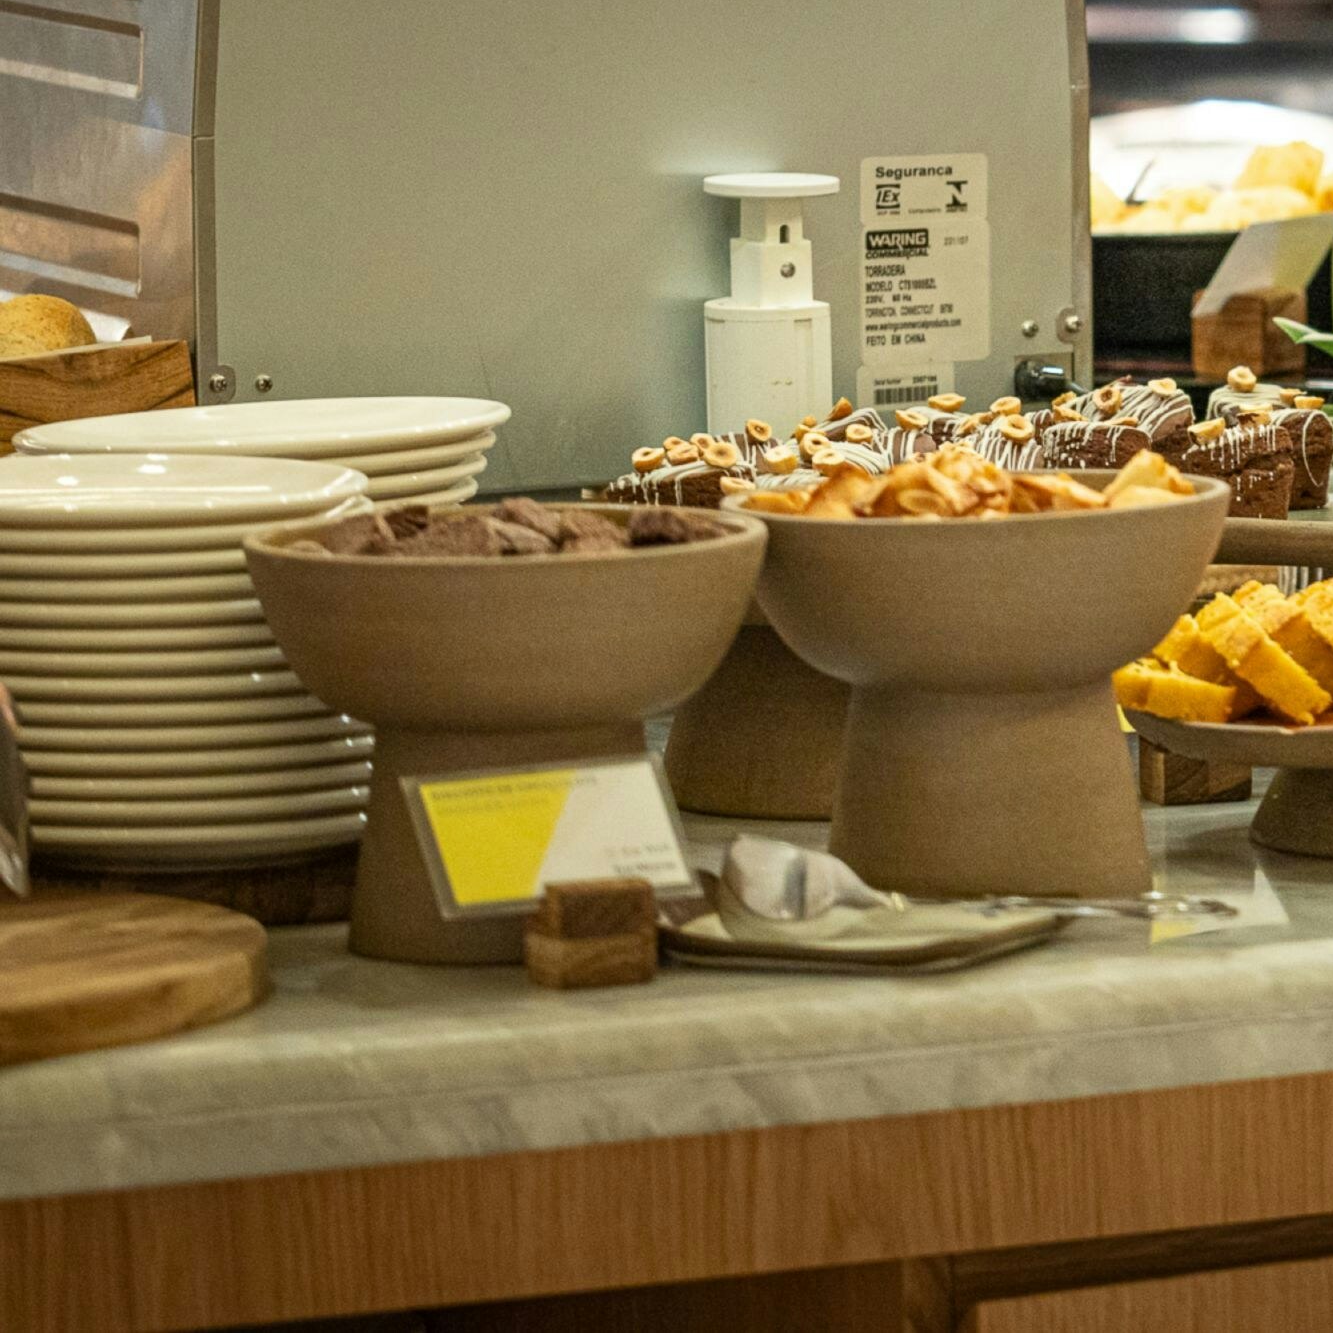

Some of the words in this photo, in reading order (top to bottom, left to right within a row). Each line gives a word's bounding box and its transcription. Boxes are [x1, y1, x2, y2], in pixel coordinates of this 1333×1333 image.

[876, 166, 953, 181] Seguranca
[868, 232, 927, 251] WARING
[865, 248, 929, 260] COMMERCIAL
